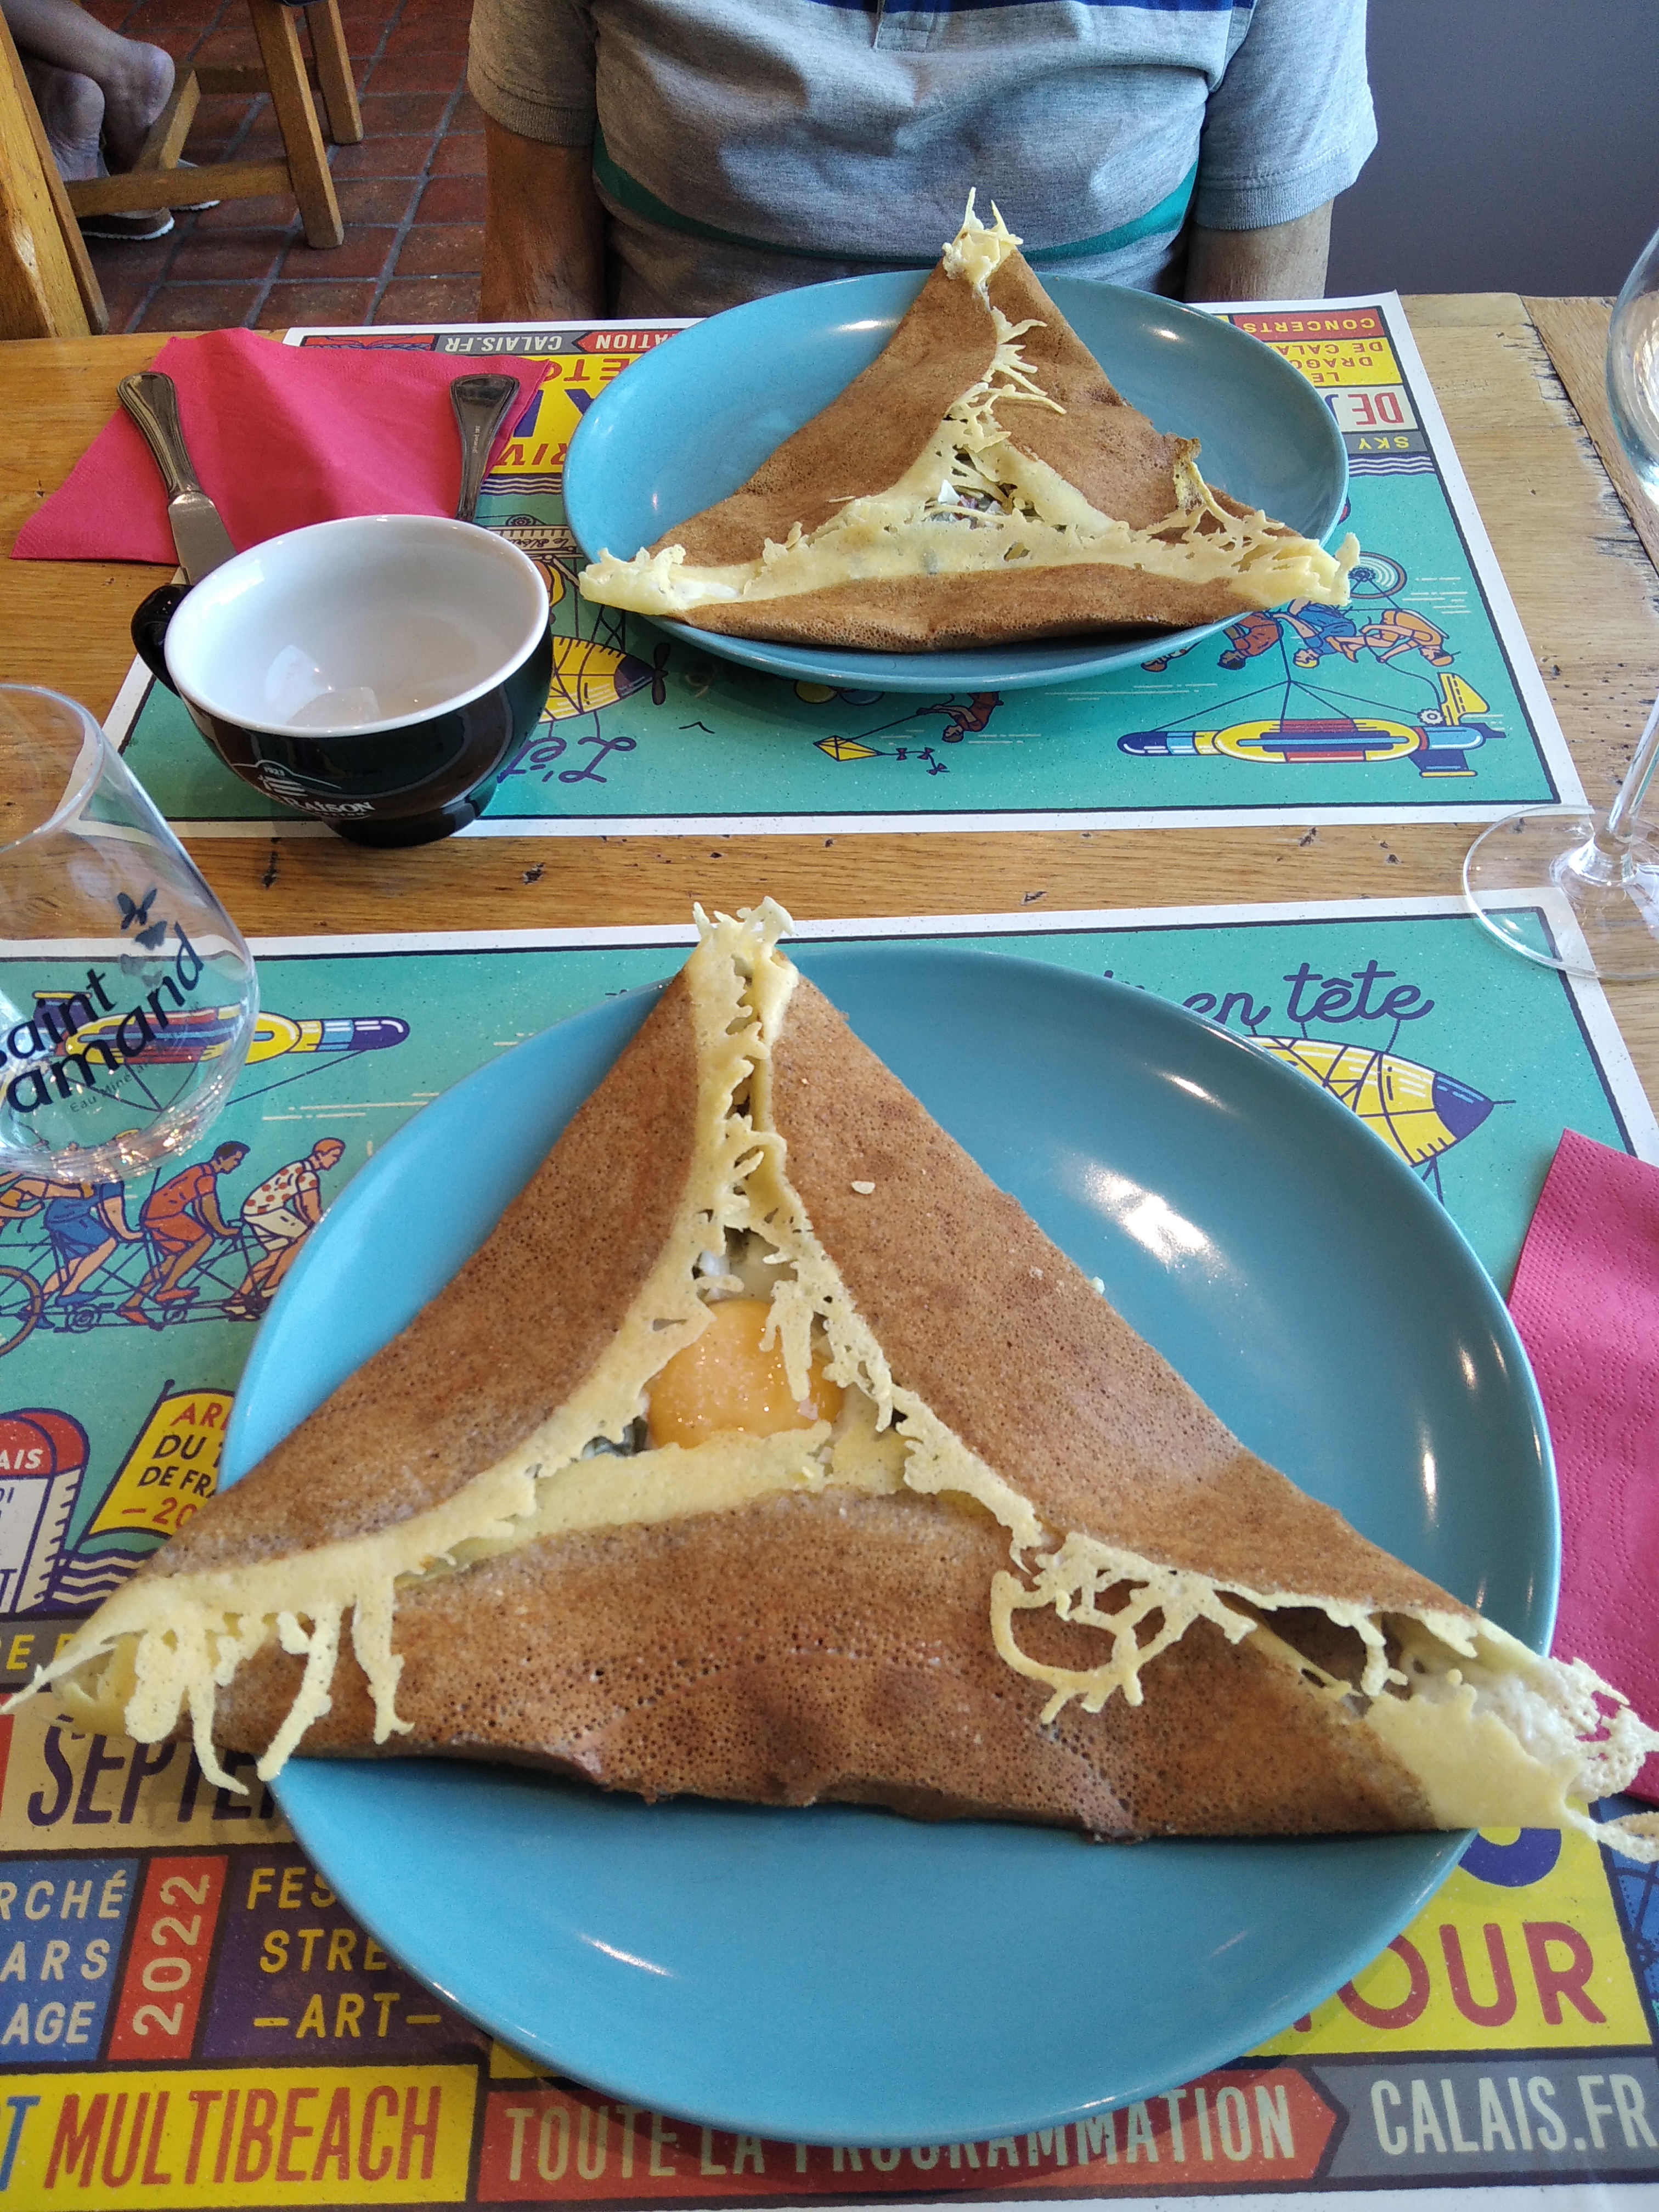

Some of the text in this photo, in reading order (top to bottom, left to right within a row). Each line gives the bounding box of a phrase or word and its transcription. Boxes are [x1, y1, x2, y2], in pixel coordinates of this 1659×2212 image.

[1243, 317, 1375, 334] CONCERTS
[444, 335, 563, 353] CALAIS.FR
[1272, 341, 1384, 354] DE CALA
[1293, 356, 1374, 369] DRAGO
[1311, 371, 1340, 383] LE
[1347, 392, 1404, 426] DE
[1358, 436, 1409, 450] SKY
[1283, 959, 1435, 1023] tête
[7, 921, 205, 1114] amand
[153, 1434, 207, 1460] DU
[138, 1465, 179, 1487] DE
[246, 1866, 337, 1910] FES
[132, 1874, 211, 2036] 2022
[1371, 2073, 1659, 2157] CALAIS.FR
[44, 2085, 443, 2190] MULTIBEACH
